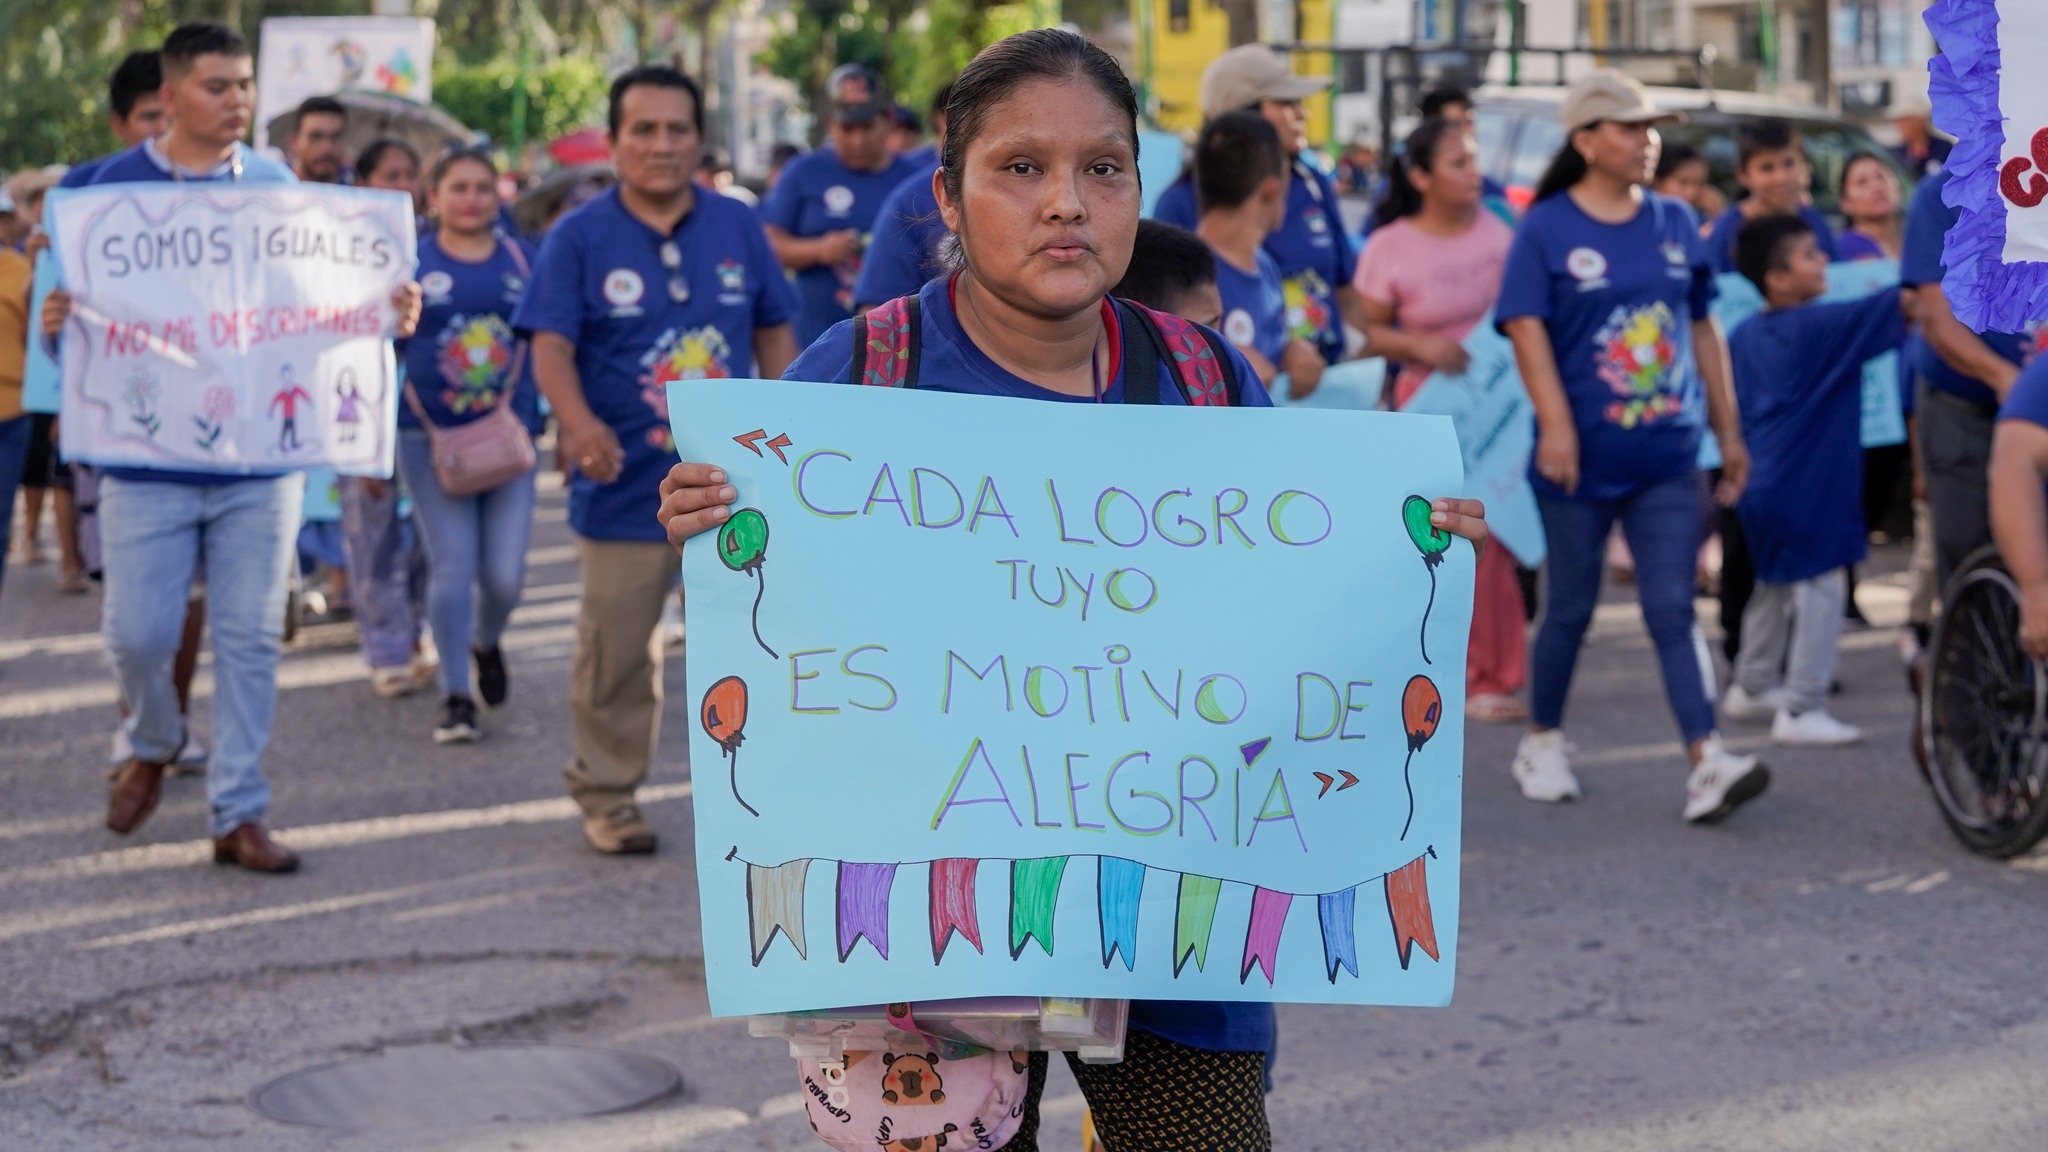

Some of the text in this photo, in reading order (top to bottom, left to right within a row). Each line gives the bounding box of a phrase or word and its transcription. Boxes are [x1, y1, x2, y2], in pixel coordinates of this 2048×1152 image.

[102, 225, 233, 279] SOMOS
[103, 319, 153, 360] NO
[1045, 478, 1331, 549] LOGRO
[994, 559, 1158, 622] TUYO
[788, 643, 897, 715] ES
[1295, 671, 1373, 742] DE
